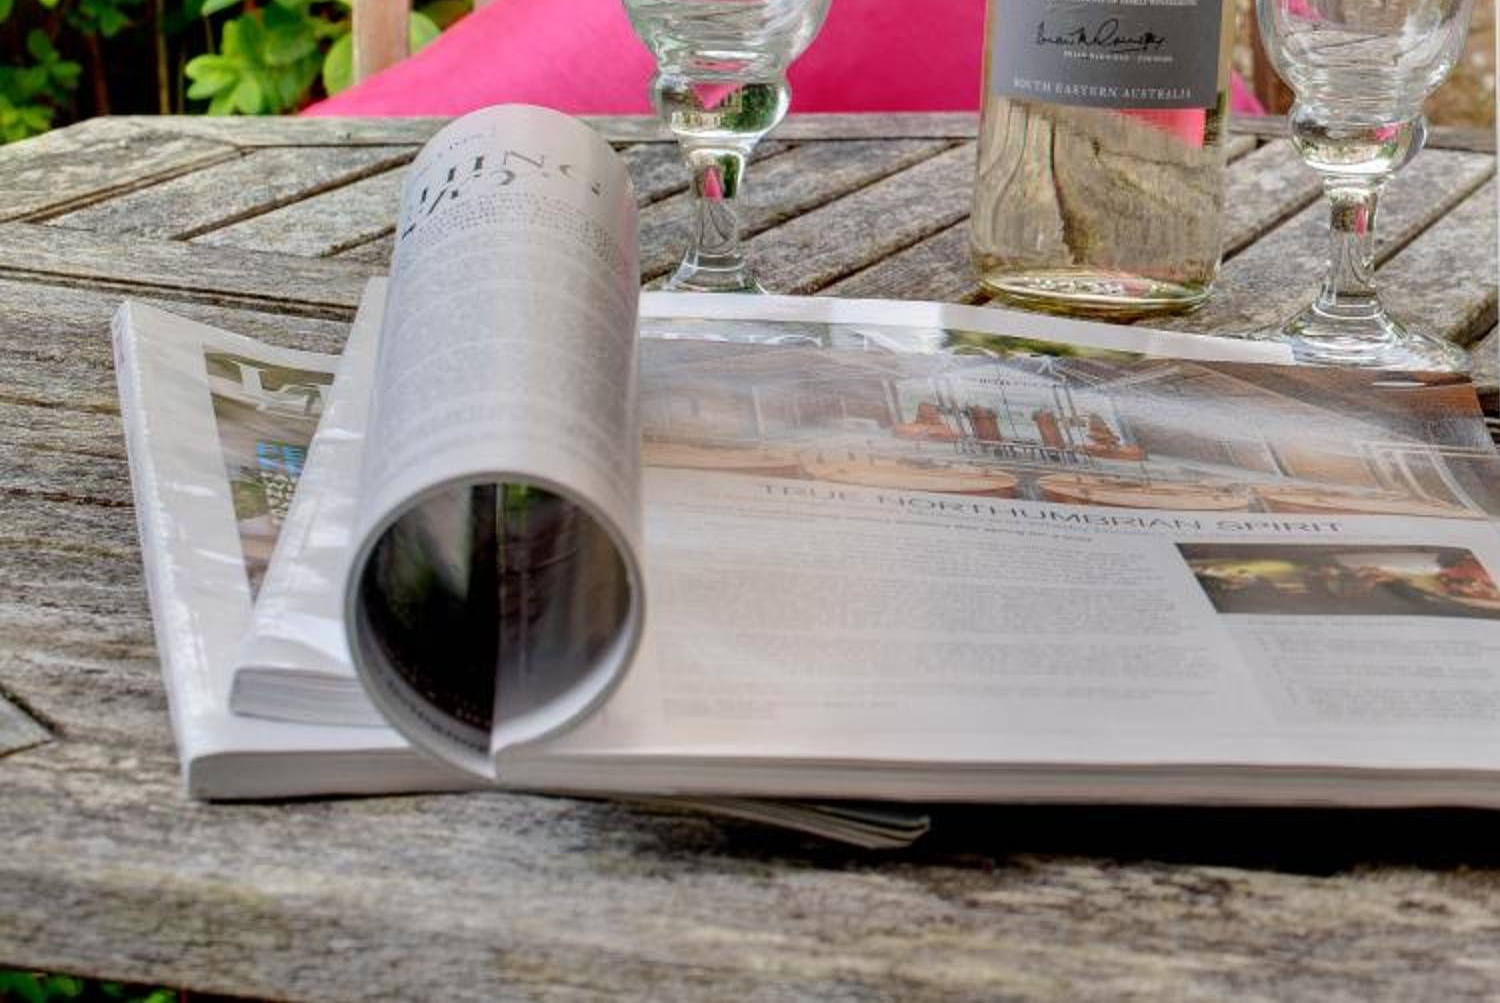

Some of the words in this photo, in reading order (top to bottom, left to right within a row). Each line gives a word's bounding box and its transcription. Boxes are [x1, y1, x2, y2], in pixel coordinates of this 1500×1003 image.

[1055, 80, 1116, 98] EASTERN
[1122, 83, 1192, 100] AUSTRALIA
[877, 493, 1202, 531] NORTHUMBRIAN
[1215, 520, 1344, 533] SPIRIT
